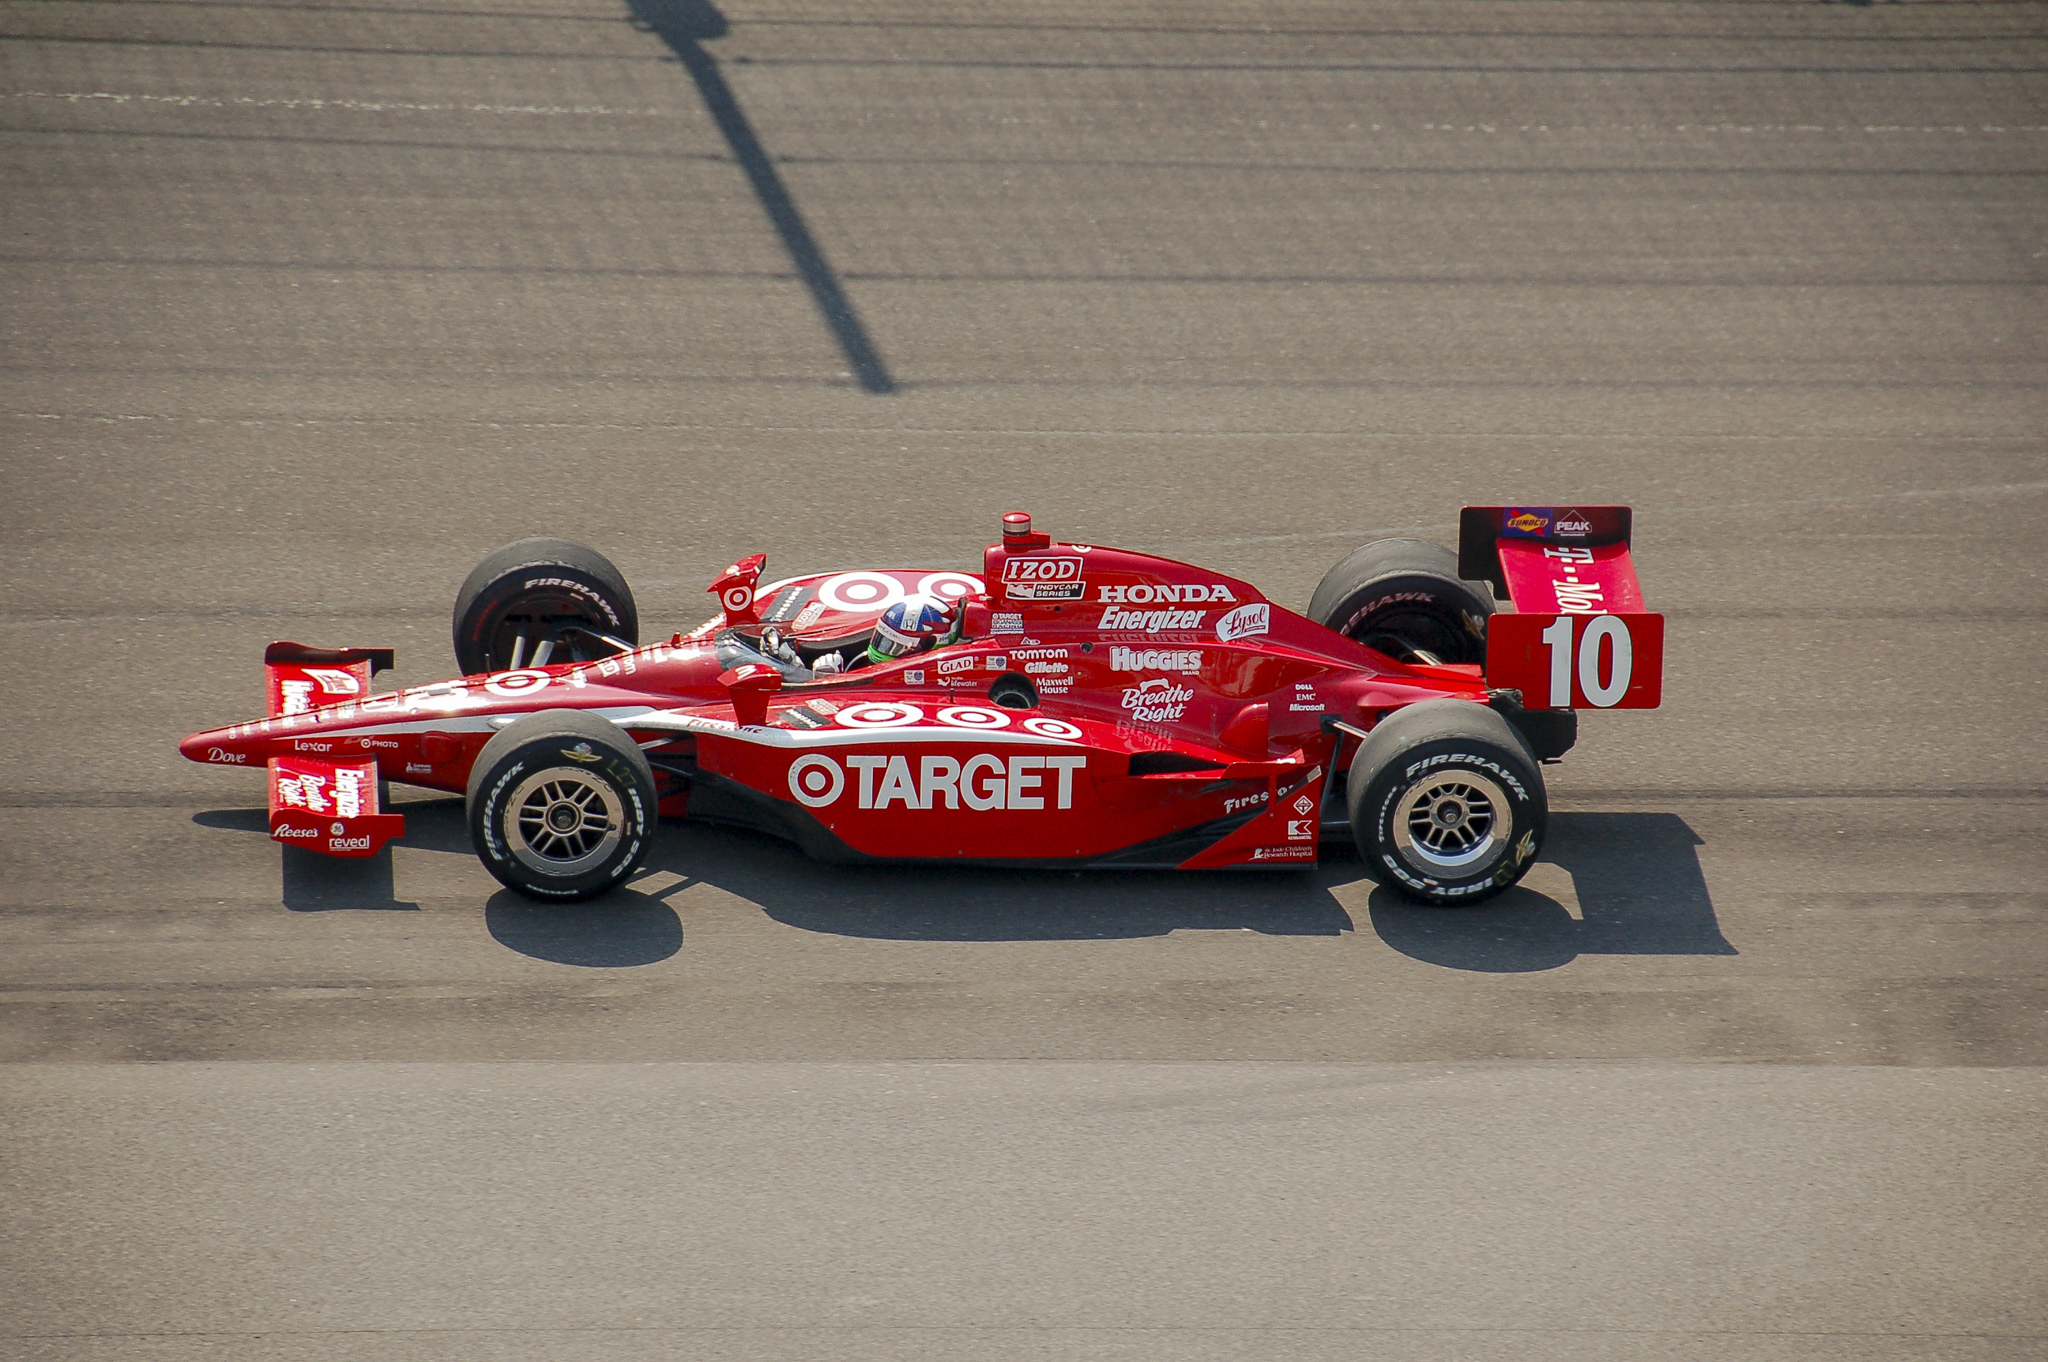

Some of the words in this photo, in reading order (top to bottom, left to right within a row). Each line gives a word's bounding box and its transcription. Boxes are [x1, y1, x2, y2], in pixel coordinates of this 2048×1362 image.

[1509, 519, 1547, 527] SUNOCO
[1556, 521, 1590, 531] PEAK
[1008, 561, 1075, 579] IZOD
[523, 577, 620, 627] FIREHAWK
[1097, 584, 1237, 603] HONDA
[1097, 605, 1207, 633] Energizer
[1226, 605, 1266, 636] Lysol
[940, 659, 972, 673] GLAD
[1109, 646, 1202, 671] HUGGIES
[1542, 615, 1633, 708] 10
[1024, 661, 1069, 674] Gillette
[1036, 676, 1074, 687] Maxwell
[1040, 685, 1069, 694] House
[1121, 684, 1194, 708] Breathe
[1132, 703, 1187, 723] Right
[1289, 703, 1325, 711] Microsoft
[294, 740, 333, 752] Lexar
[372, 740, 399, 749] PHOTO
[208, 747, 246, 763] Dove
[846, 753, 1087, 811] TARGET
[1406, 753, 1529, 802] FIREHAWK
[483, 761, 525, 861] FIREHAWK
[273, 823, 318, 837] Reese's
[329, 835, 370, 848] reveal
